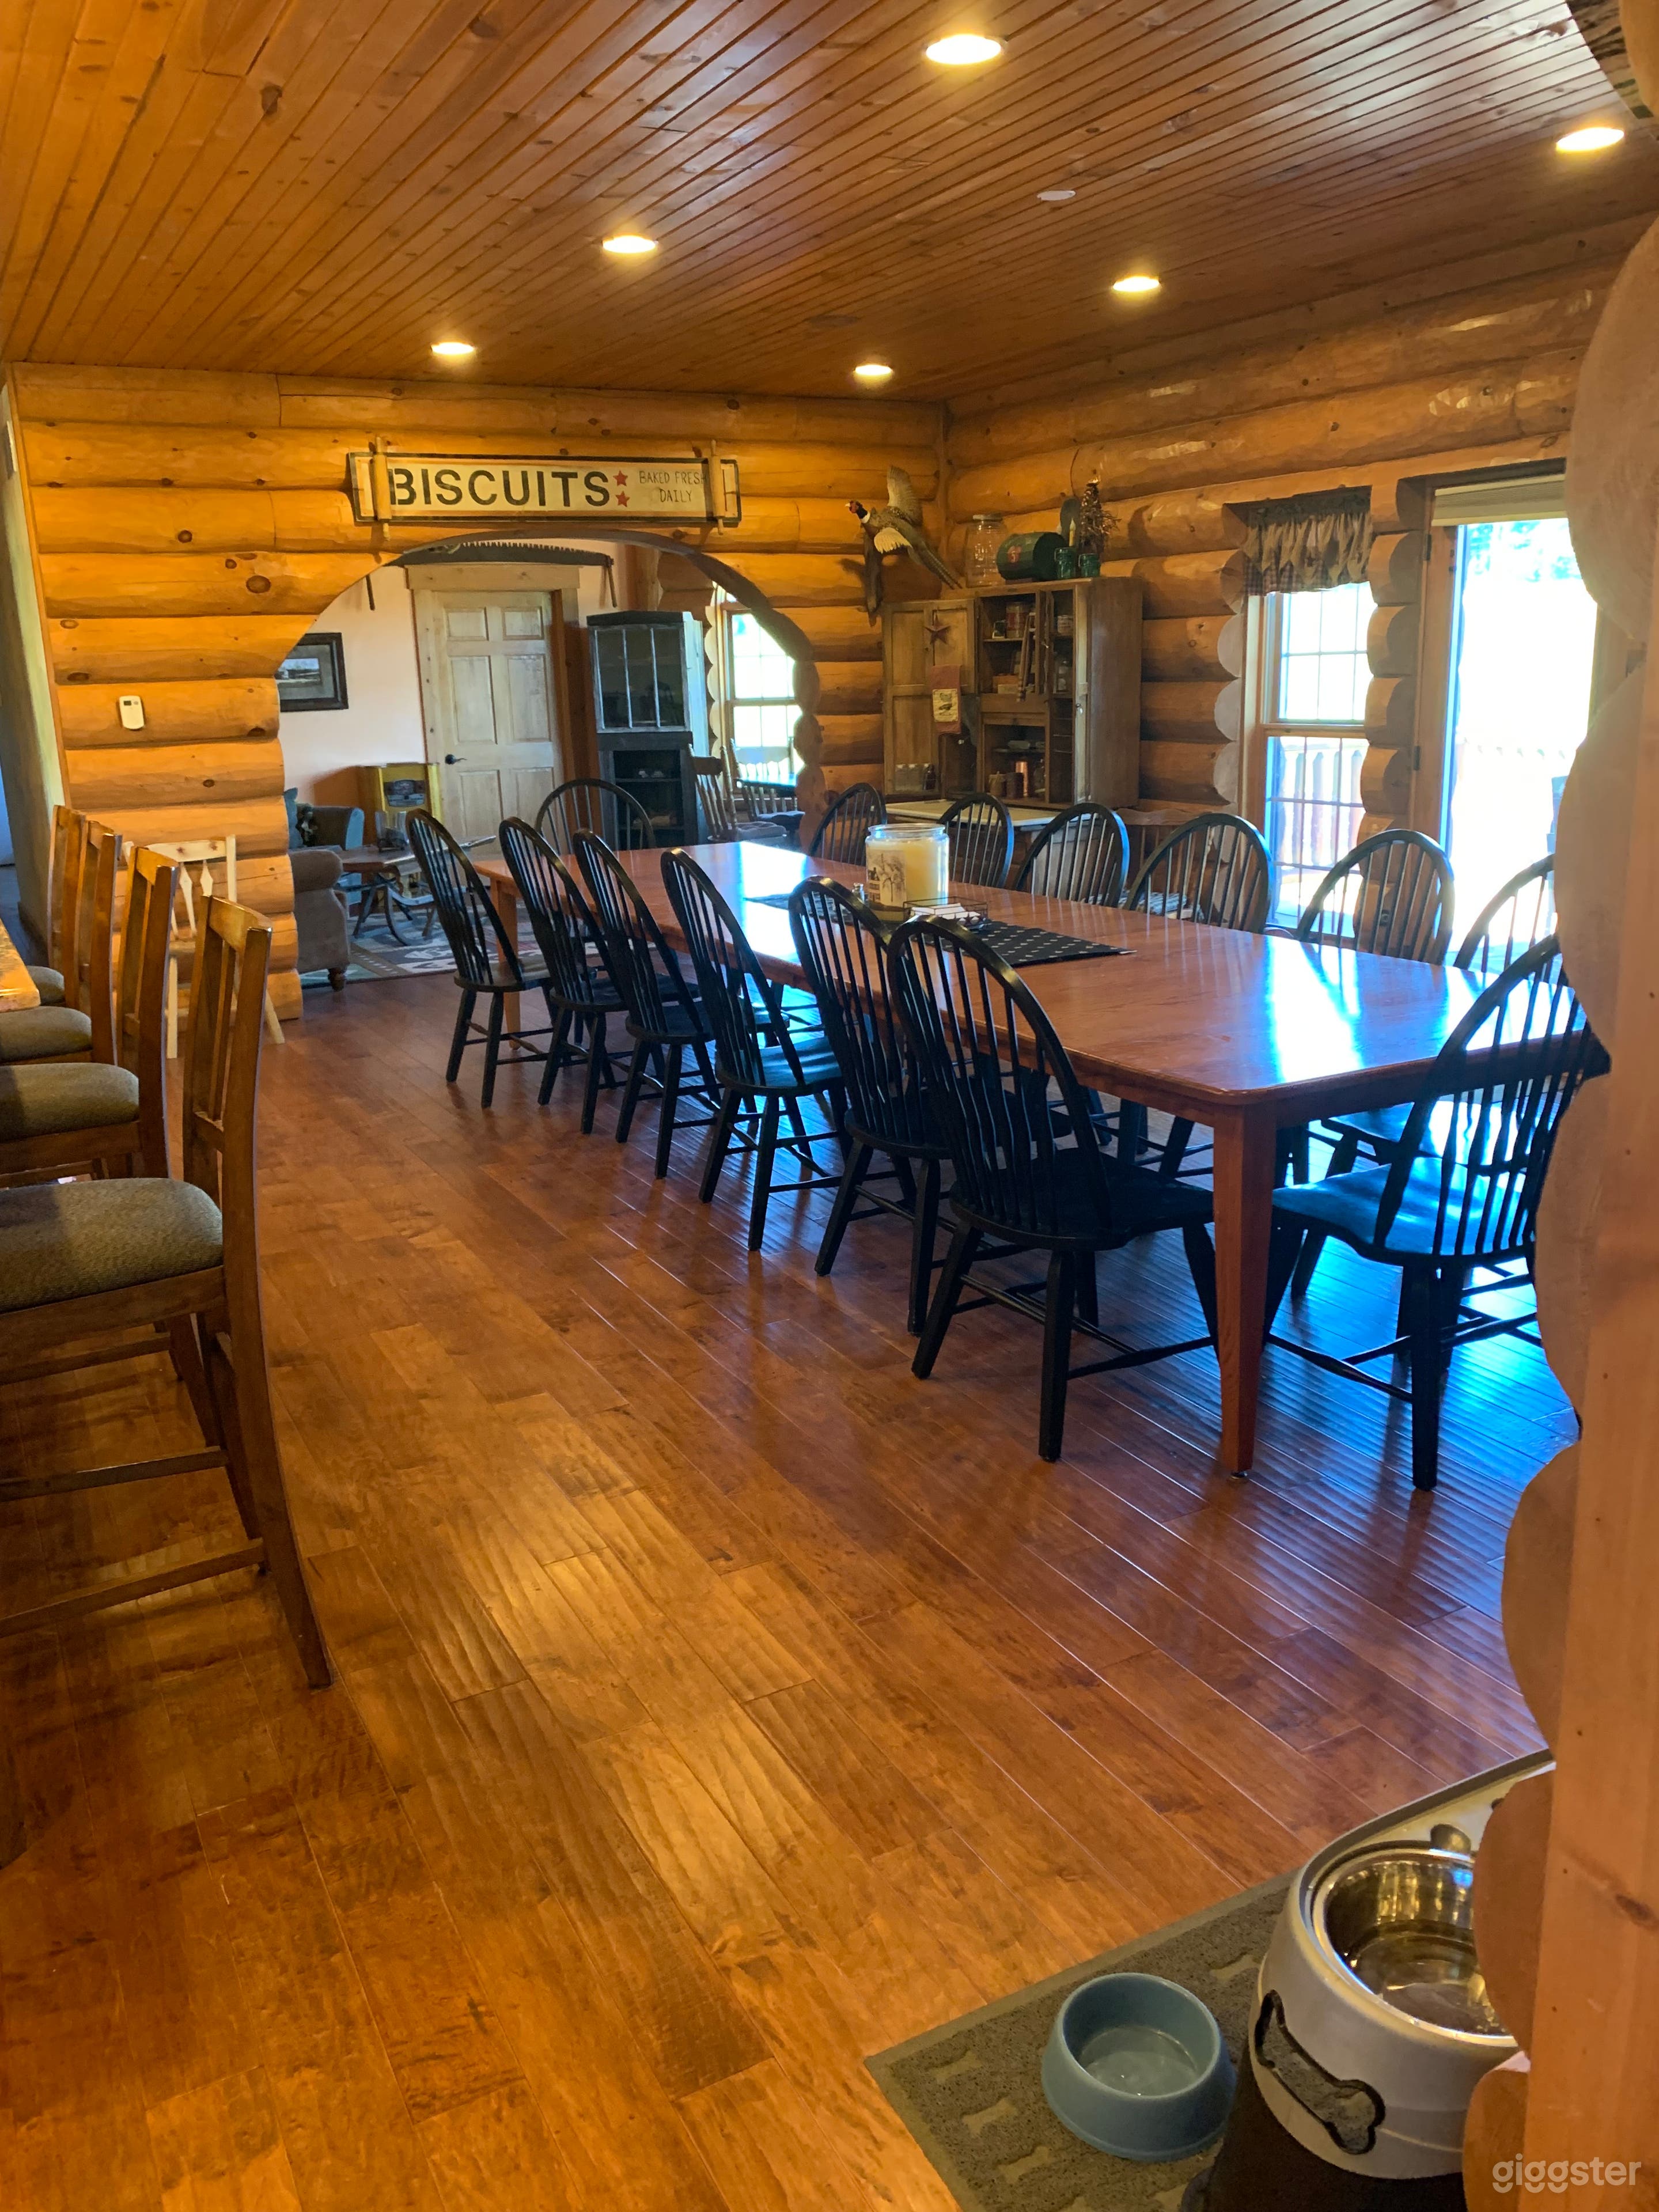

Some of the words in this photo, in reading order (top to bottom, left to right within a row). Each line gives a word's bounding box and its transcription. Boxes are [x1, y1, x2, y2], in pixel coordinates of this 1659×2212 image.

[639, 470, 670, 484] BAKED
[675, 471, 707, 484] FRESH
[387, 468, 610, 507] BISCUITS
[659, 487, 692, 503] DAILY
